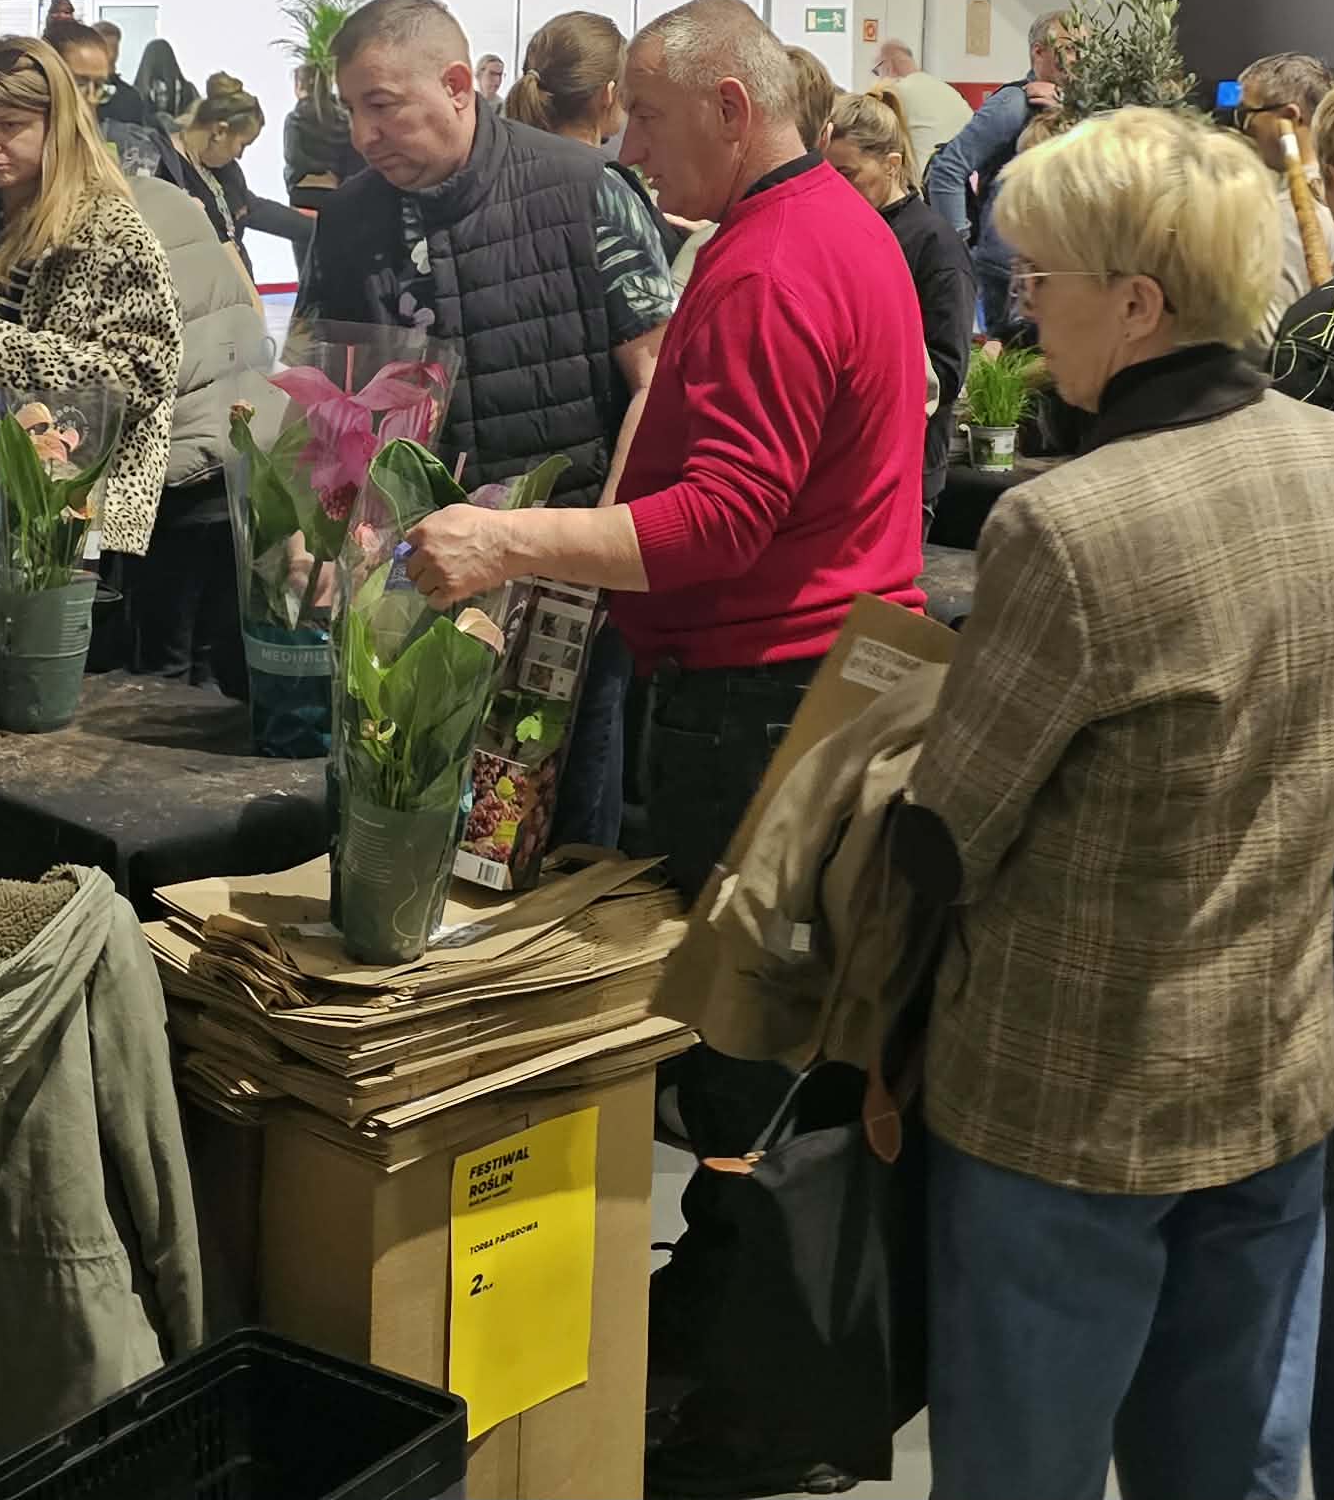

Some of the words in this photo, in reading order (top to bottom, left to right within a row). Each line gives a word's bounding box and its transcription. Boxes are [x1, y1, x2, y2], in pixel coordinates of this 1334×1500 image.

[469, 1146, 530, 1179] FESTIWAL
[468, 1169, 514, 1199] ROŚLIN
[470, 1239, 493, 1255] TORBA
[470, 1274, 483, 1297] 2
